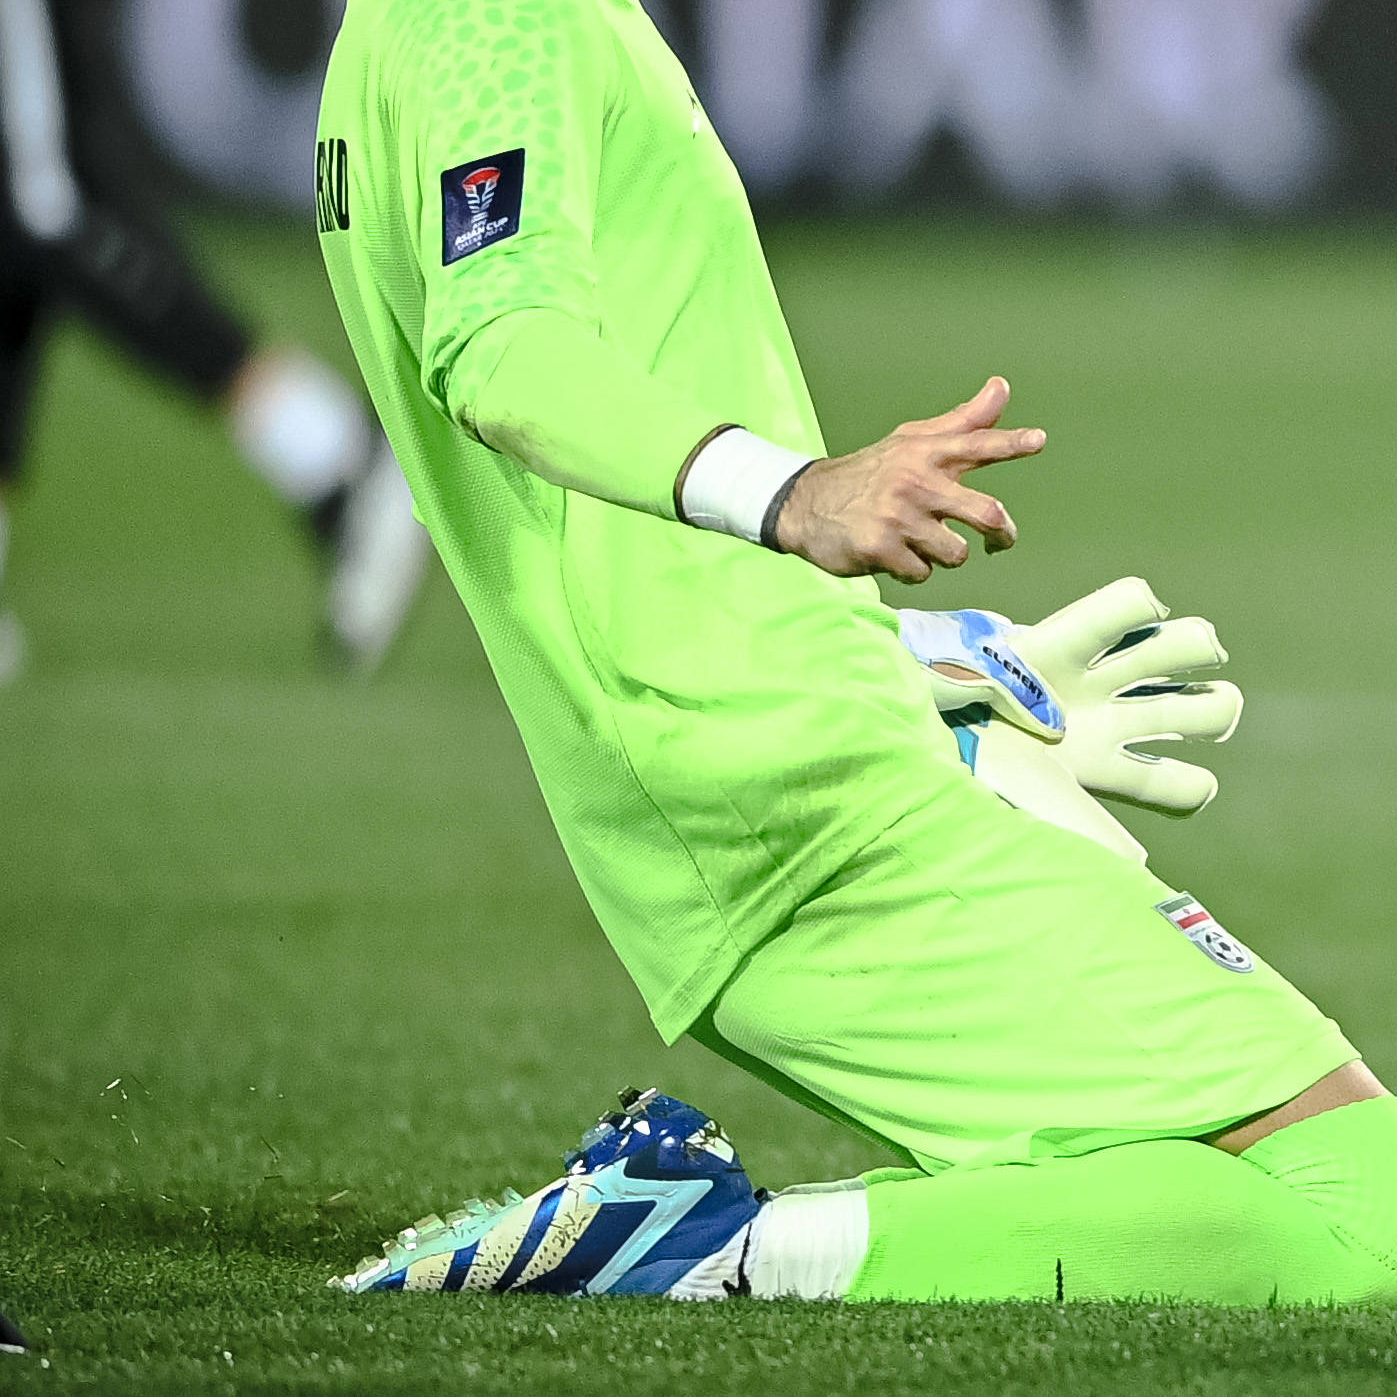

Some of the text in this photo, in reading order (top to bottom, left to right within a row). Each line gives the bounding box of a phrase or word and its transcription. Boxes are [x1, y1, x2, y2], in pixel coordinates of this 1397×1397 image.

[454, 224, 486, 247] ASIAN
[485, 216, 509, 231] CUP
[982, 645, 1043, 700] ELEMENT
